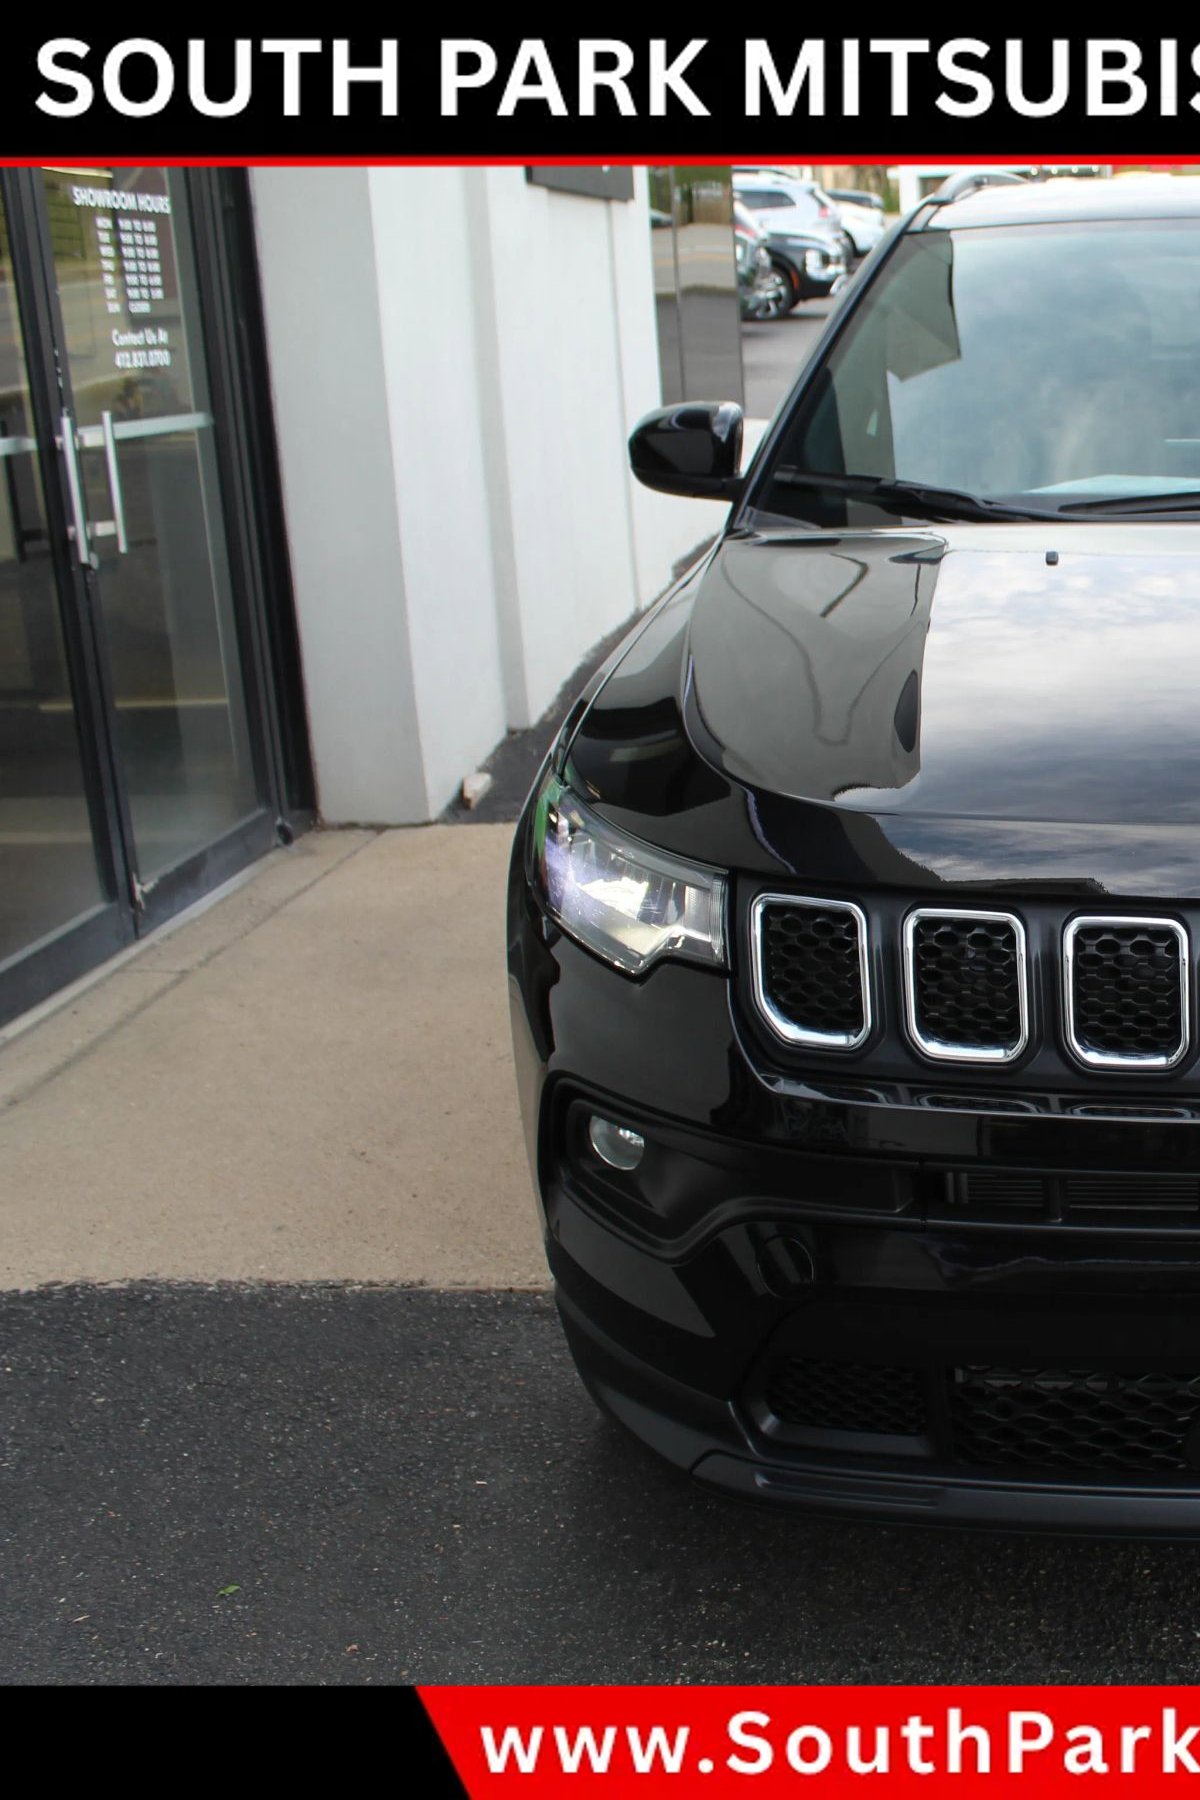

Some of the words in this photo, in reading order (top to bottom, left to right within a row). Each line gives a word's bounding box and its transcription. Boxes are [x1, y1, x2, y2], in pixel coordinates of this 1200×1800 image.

[72, 186, 137, 210] SHOWROOM
[136, 192, 170, 214] HOURS
[112, 329, 145, 346] Contact
[144, 328, 157, 345] Us
